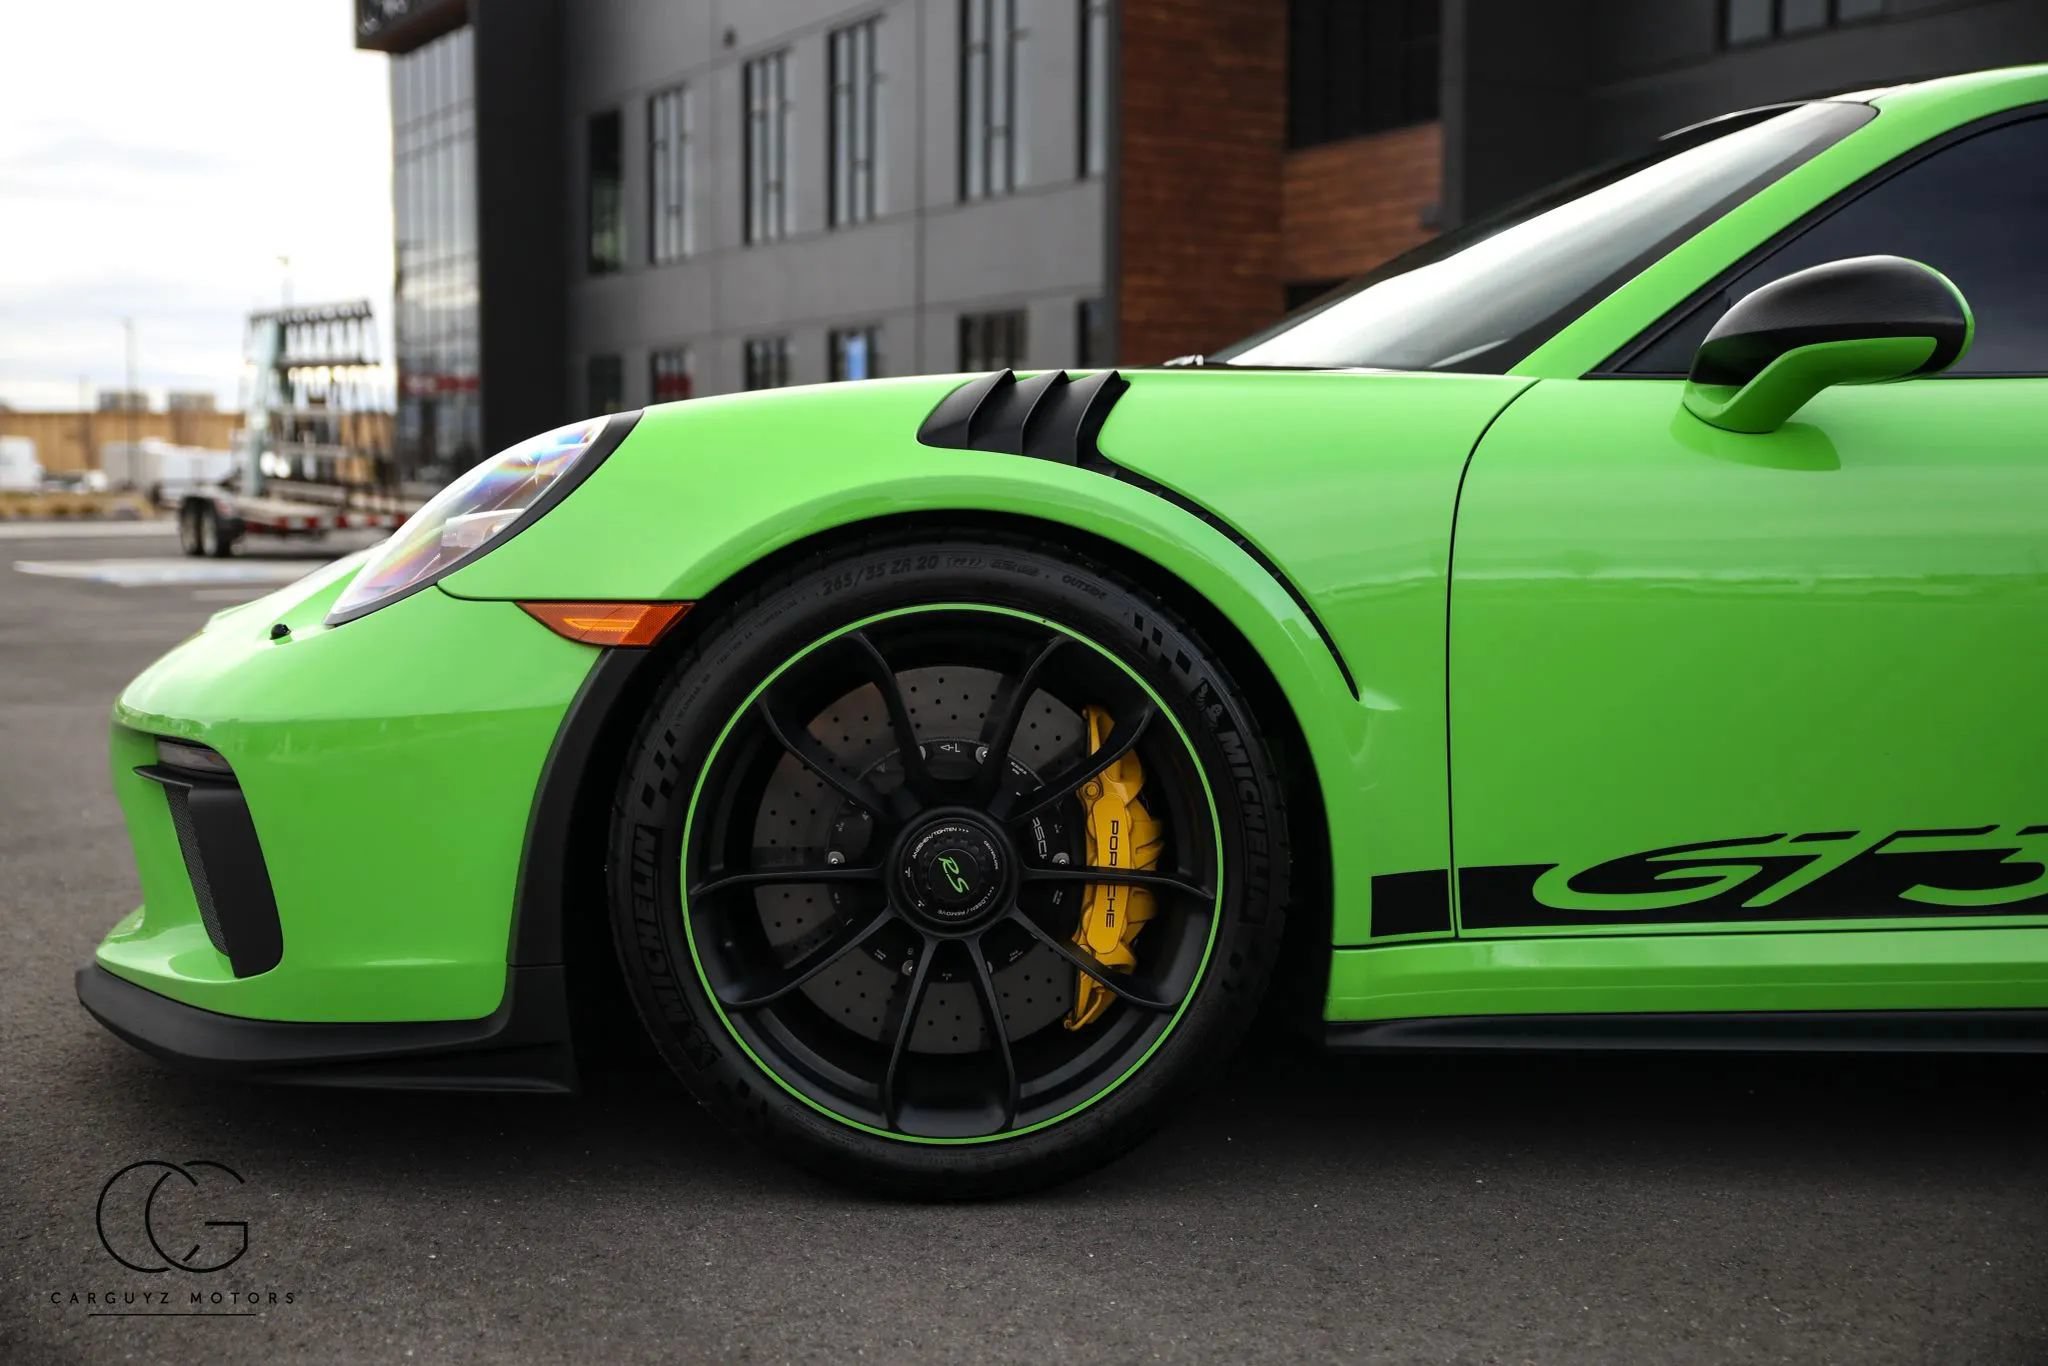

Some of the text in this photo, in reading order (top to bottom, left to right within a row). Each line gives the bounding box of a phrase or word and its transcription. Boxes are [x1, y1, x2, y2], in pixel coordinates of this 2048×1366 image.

[917, 555, 939, 570] 20
[1062, 574, 1108, 600] OUTSIDE
[1217, 730, 1271, 923] MICHELIN
[1532, 824, 2048, 911] GT3
[938, 857, 970, 893] RS
[1105, 820, 1120, 929] PORCHE
[631, 823, 696, 1022] MICHELIN
